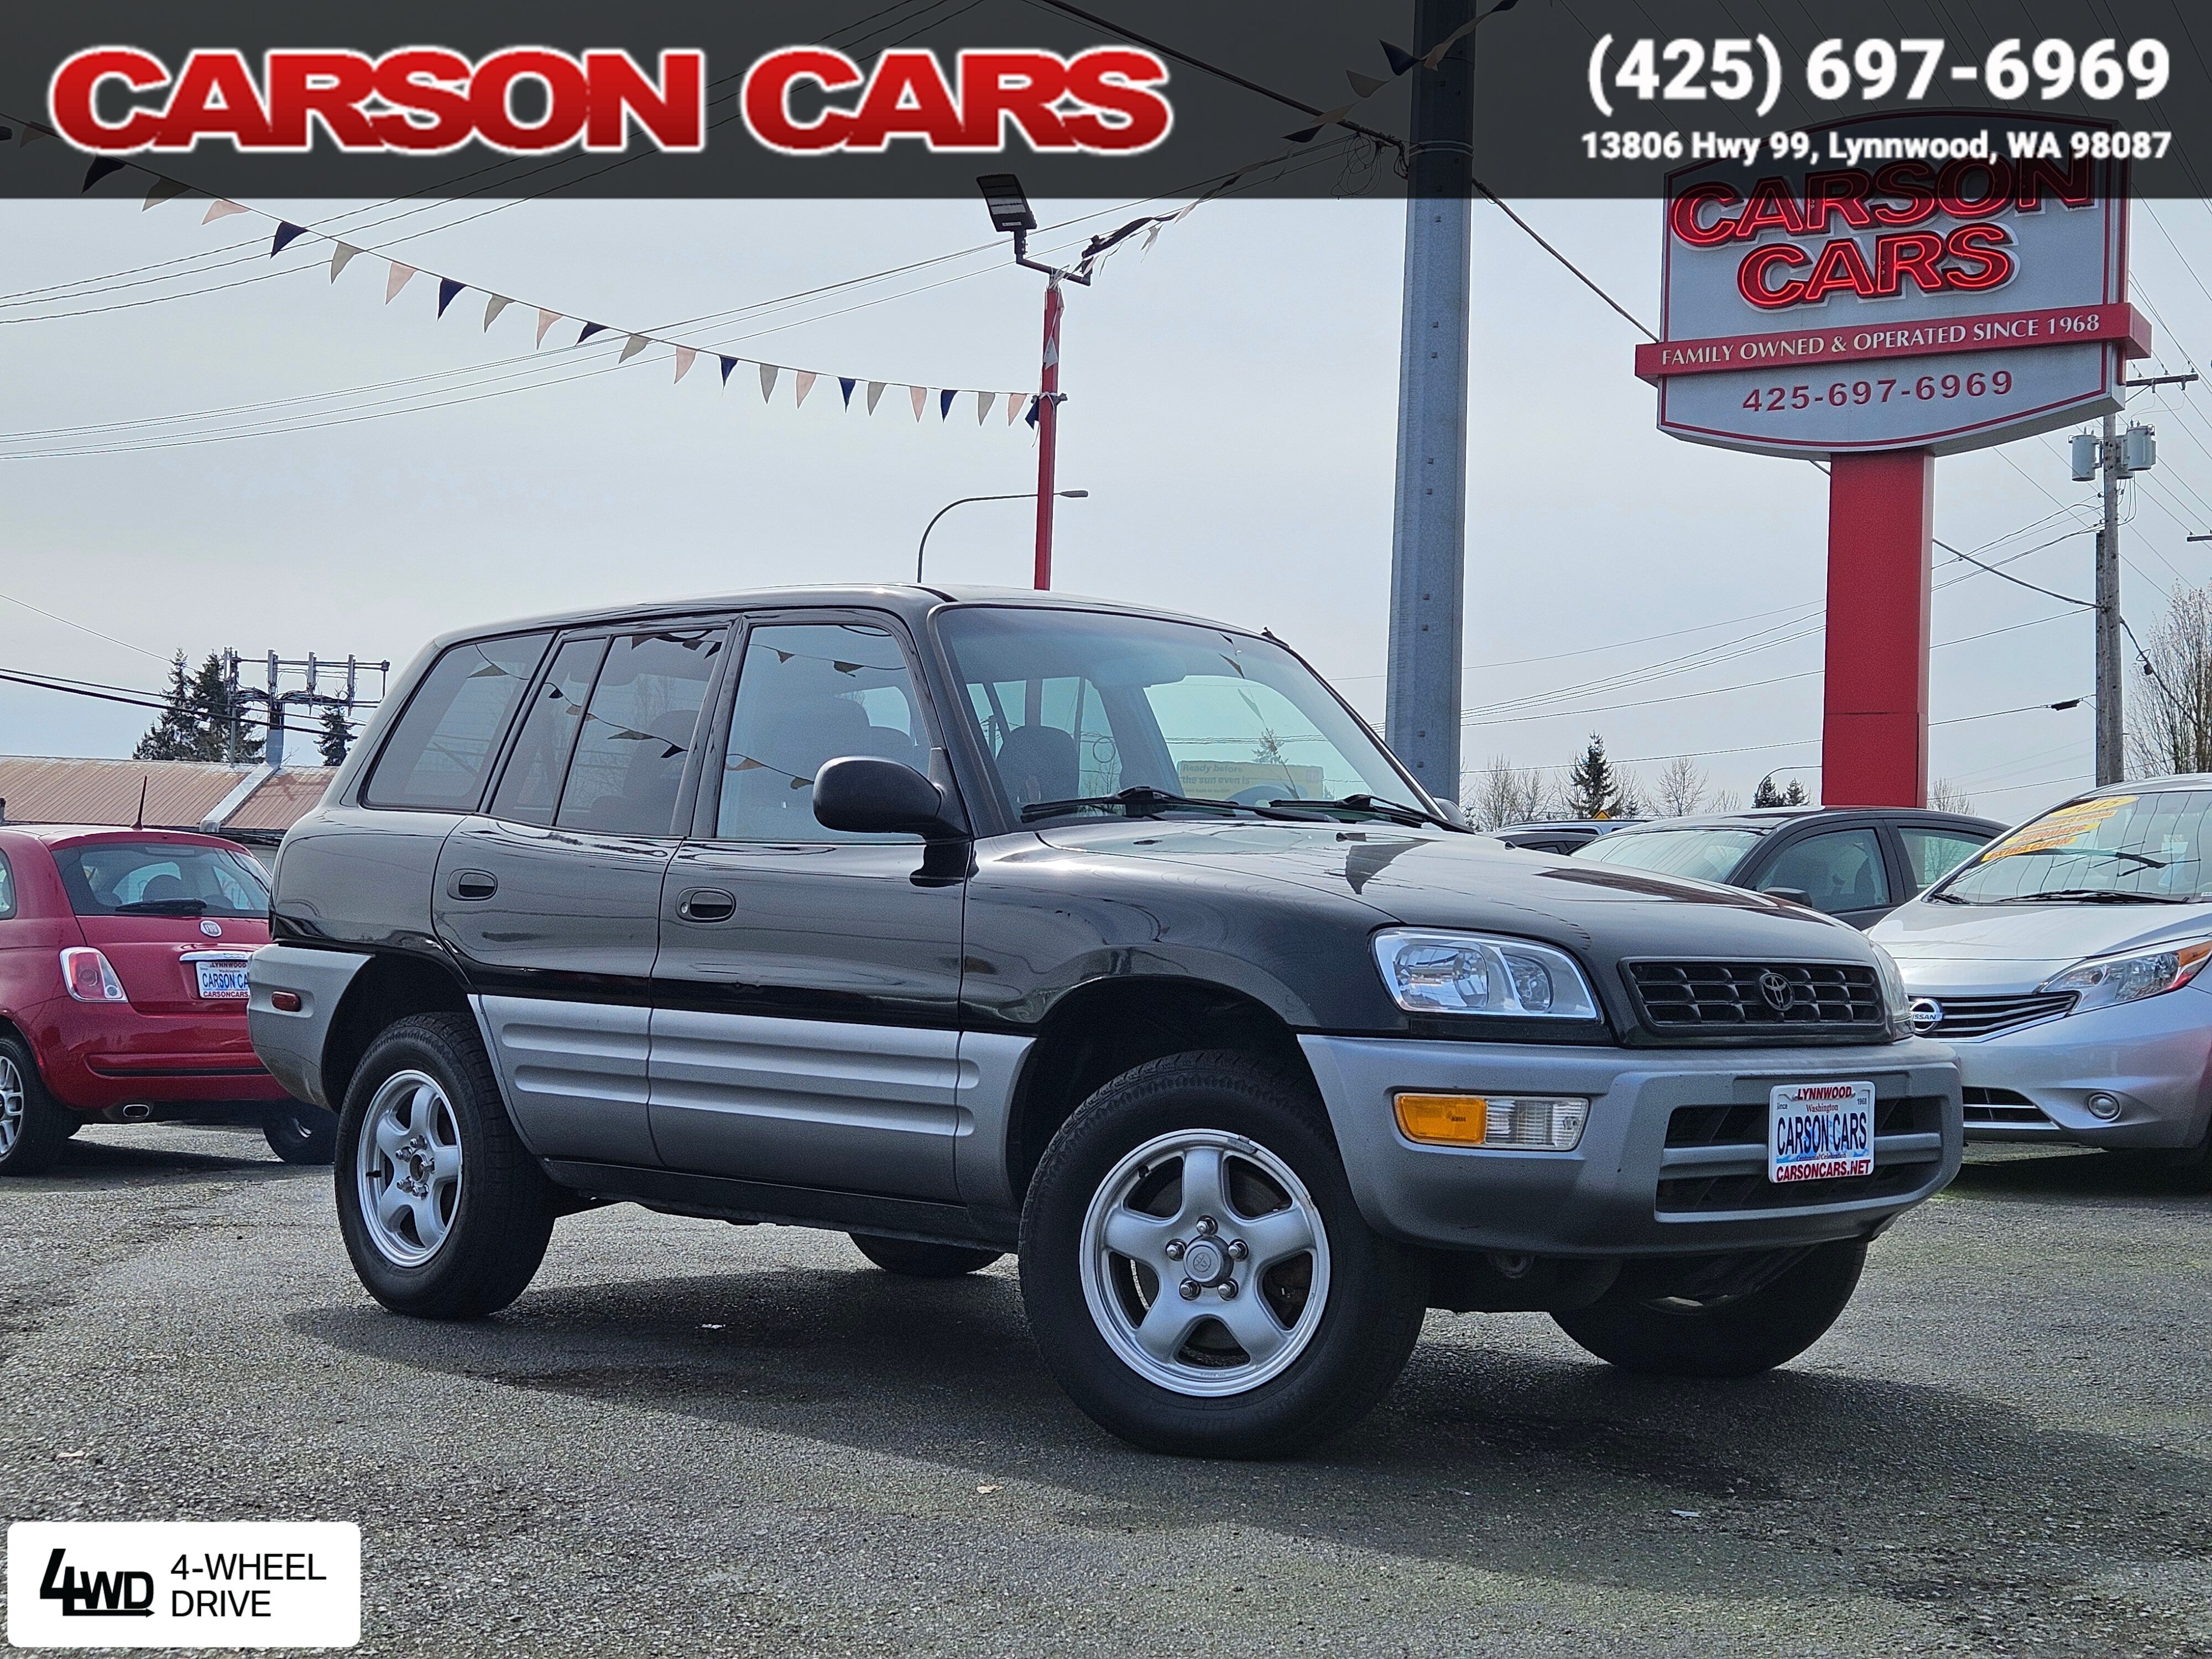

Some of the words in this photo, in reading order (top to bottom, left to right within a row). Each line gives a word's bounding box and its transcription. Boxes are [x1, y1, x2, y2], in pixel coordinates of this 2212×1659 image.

[1670, 147, 2097, 248] CARSON
[1736, 222, 2016, 311] CARS
[1662, 345, 1734, 366] FAMILY
[1740, 337, 1824, 360] OWNED
[1831, 336, 1846, 352] &
[1854, 325, 1966, 351] OPERATED
[1973, 319, 2039, 341] SINCE
[2047, 314, 2100, 335] 1968
[1743, 371, 2012, 412] 425-697-6969
[1183, 764, 1212, 774] Ready
[1213, 764, 1243, 773] before
[1182, 776, 1197, 784] the
[1241, 776, 1250, 785] is
[2016, 823, 2088, 843] AUTOMATIC
[1989, 844, 2030, 859] EXTRA
[2028, 837, 2073, 851] CLEAN
[202, 973, 236, 988] CARSON
[1797, 1086, 1852, 1100] LYNNWOOD
[1806, 1103, 1839, 1113] Washington
[1777, 1115, 1829, 1156] CARSON
[1833, 1112, 1867, 1152] CARS
[1776, 1159, 1871, 1182] CARSONCARS.NET
